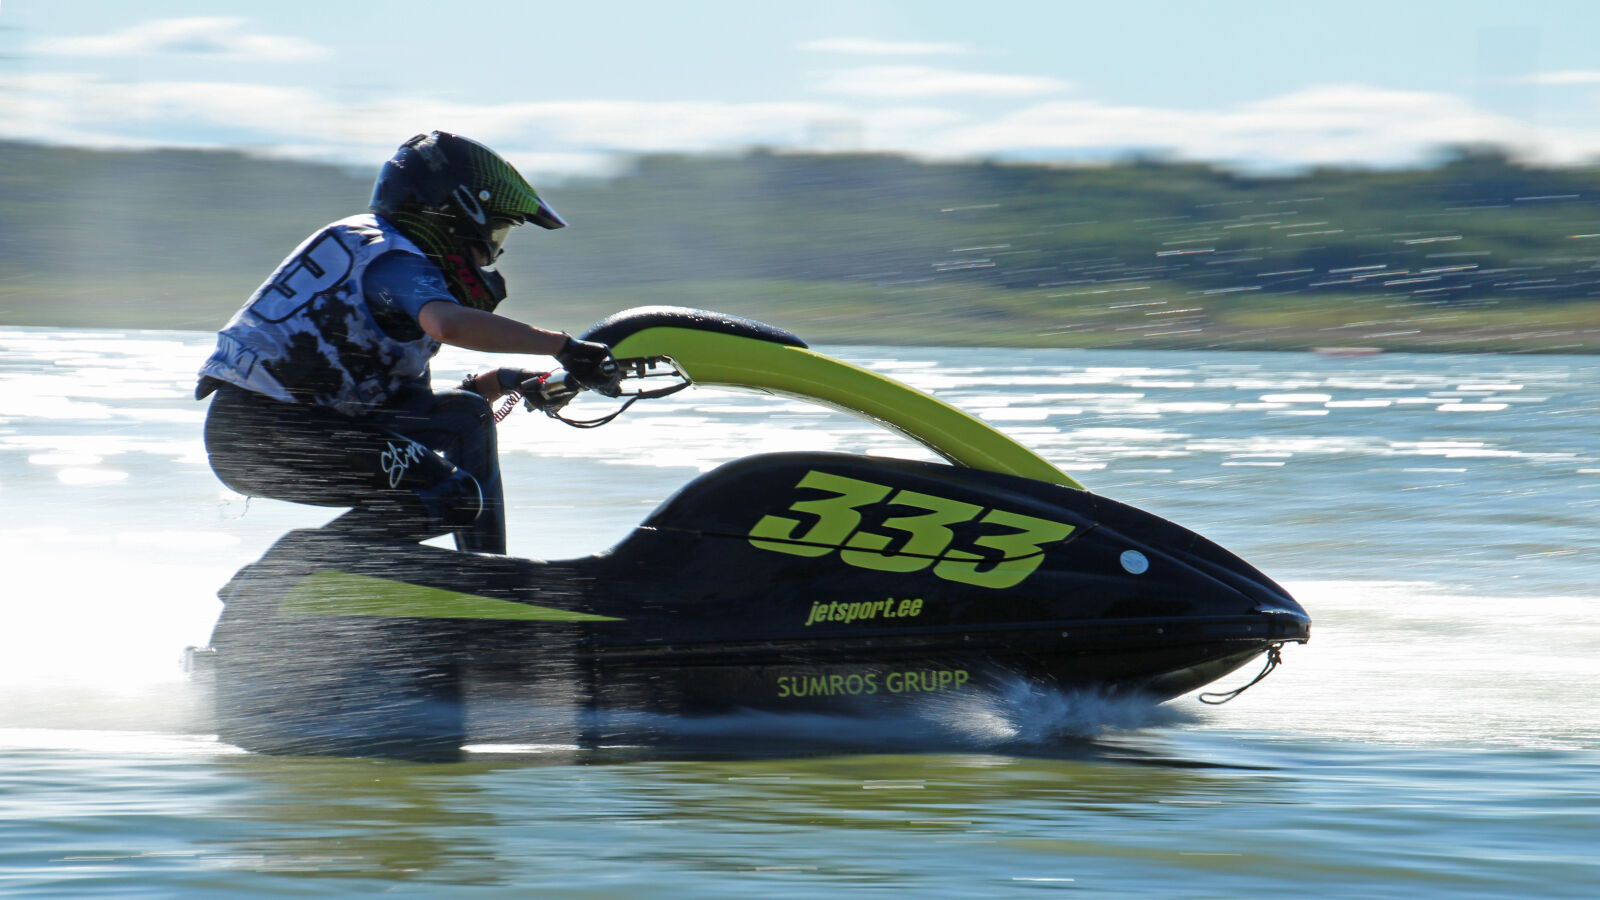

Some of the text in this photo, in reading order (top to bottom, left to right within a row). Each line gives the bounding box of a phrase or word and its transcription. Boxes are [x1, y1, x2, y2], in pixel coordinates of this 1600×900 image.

[748, 470, 1076, 589] 333
[804, 597, 924, 626] jetsport.ee
[776, 669, 970, 698] SUMROS GRUPP
